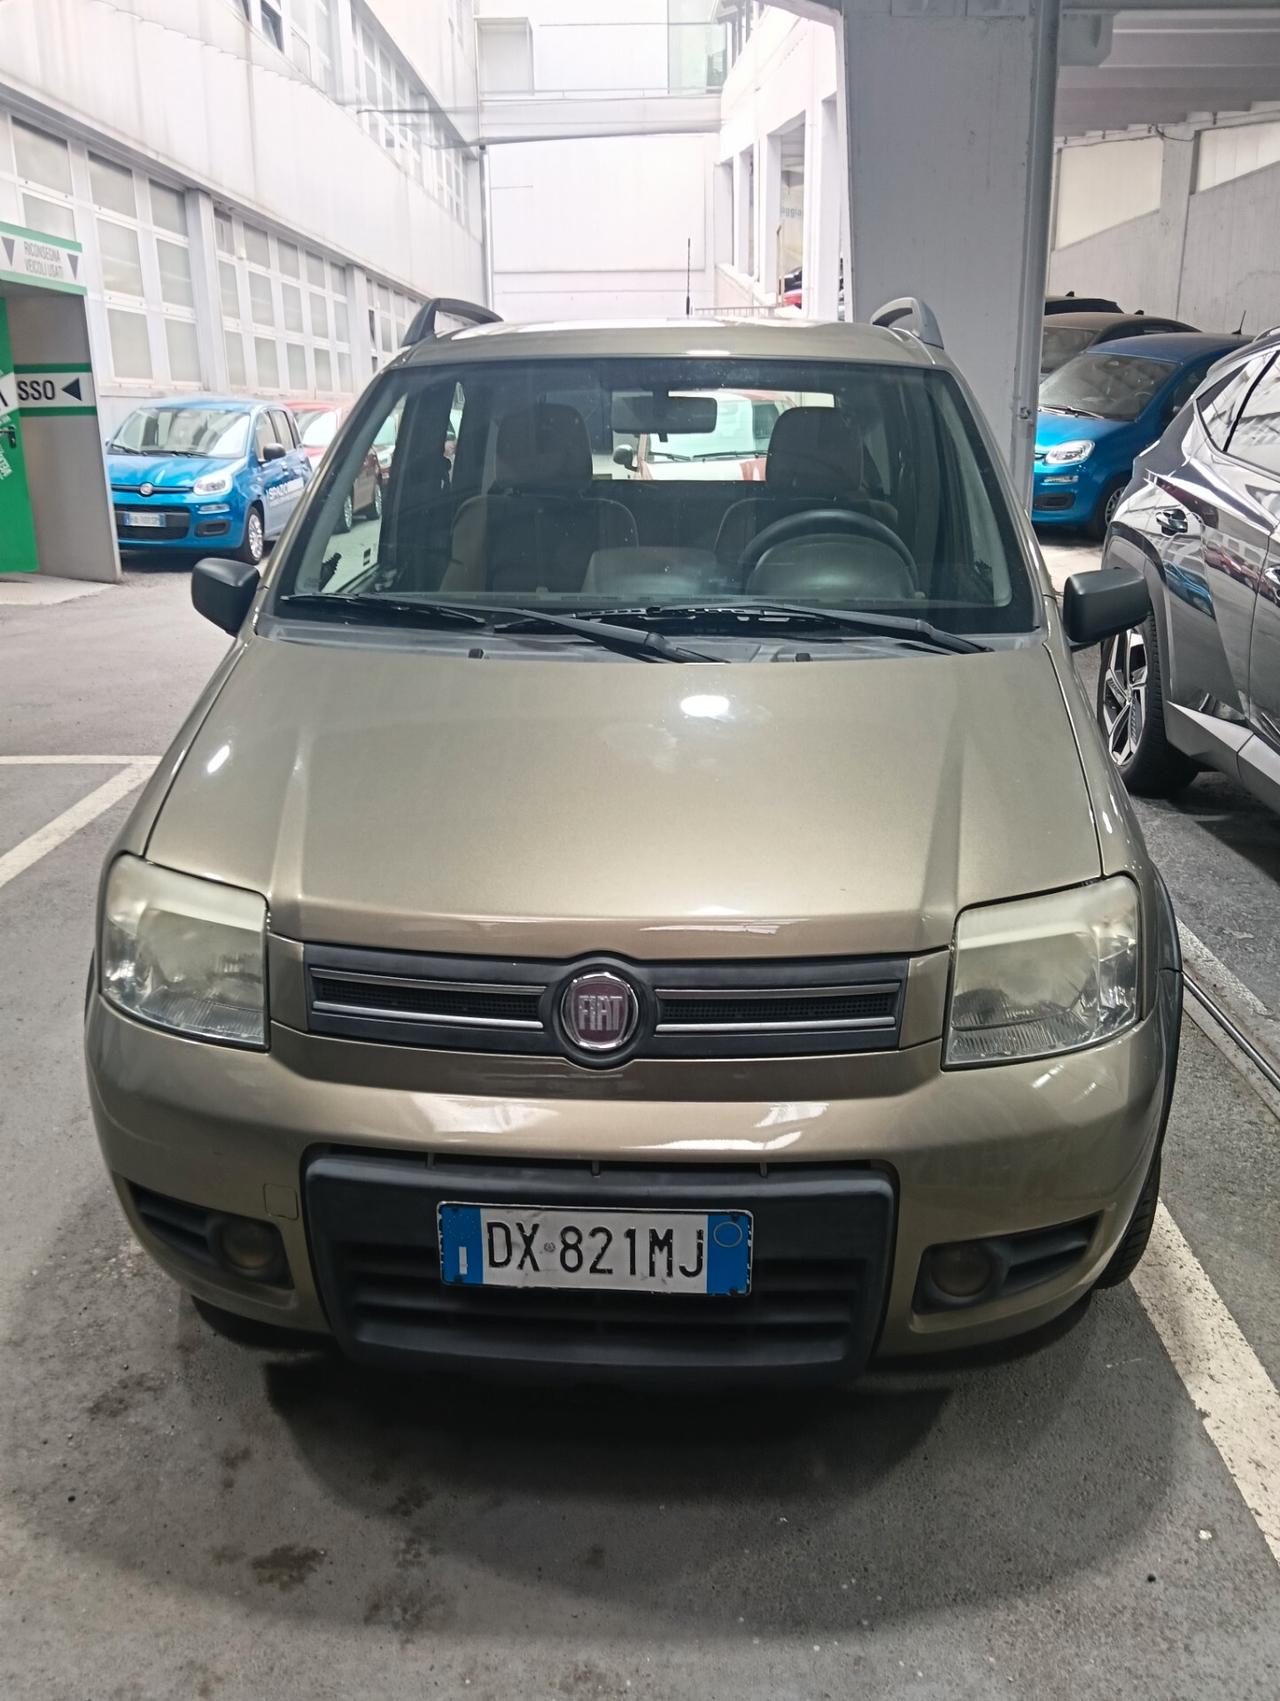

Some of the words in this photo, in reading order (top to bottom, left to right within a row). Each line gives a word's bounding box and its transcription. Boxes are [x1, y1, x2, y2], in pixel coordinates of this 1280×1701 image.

[579, 995, 622, 1031] FIAT
[487, 1221, 540, 1272] DX
[559, 1225, 704, 1278] 821MJ
